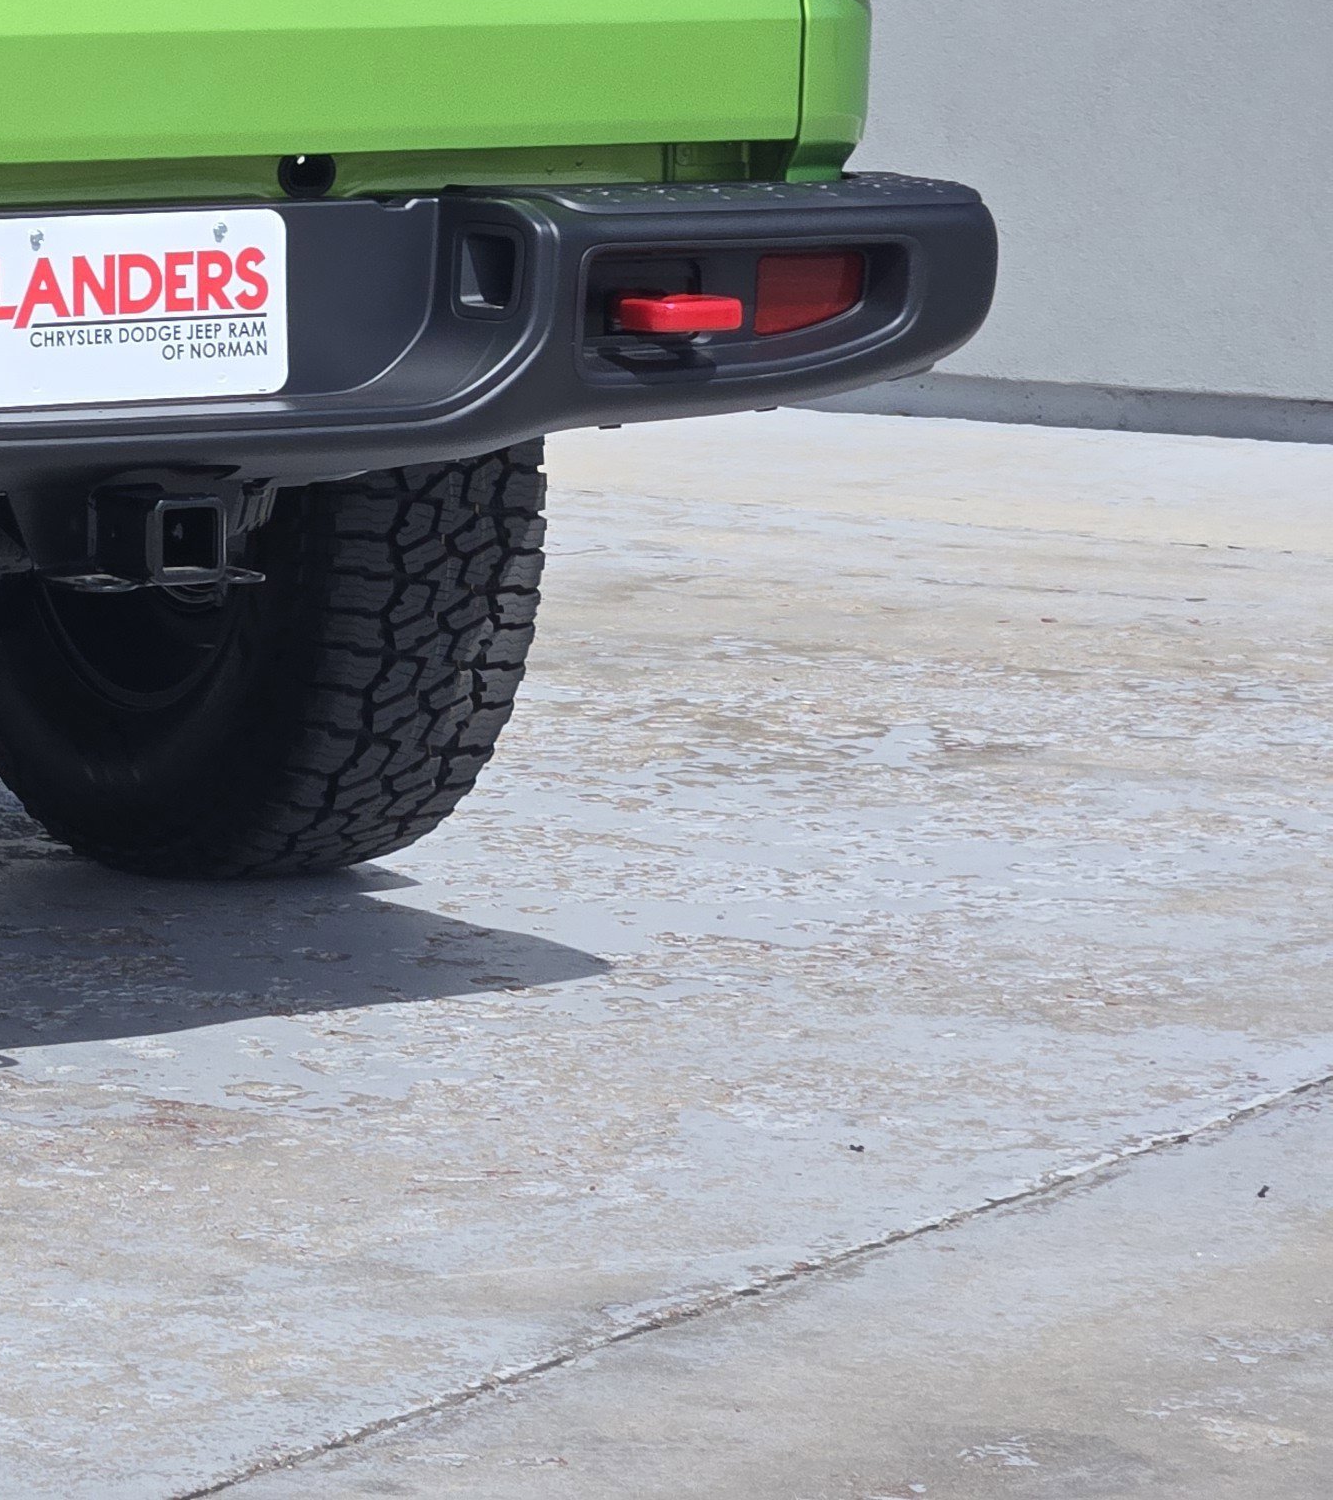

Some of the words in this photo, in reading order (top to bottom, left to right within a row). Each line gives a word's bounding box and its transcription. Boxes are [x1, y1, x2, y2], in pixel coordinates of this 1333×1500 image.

[29, 328, 113, 348] CHRYSLER
[118, 325, 181, 343] DODGE
[186, 323, 222, 340] JEEP
[228, 321, 267, 339] RAM
[161, 344, 185, 361] OF
[189, 339, 268, 360] NORMAN
